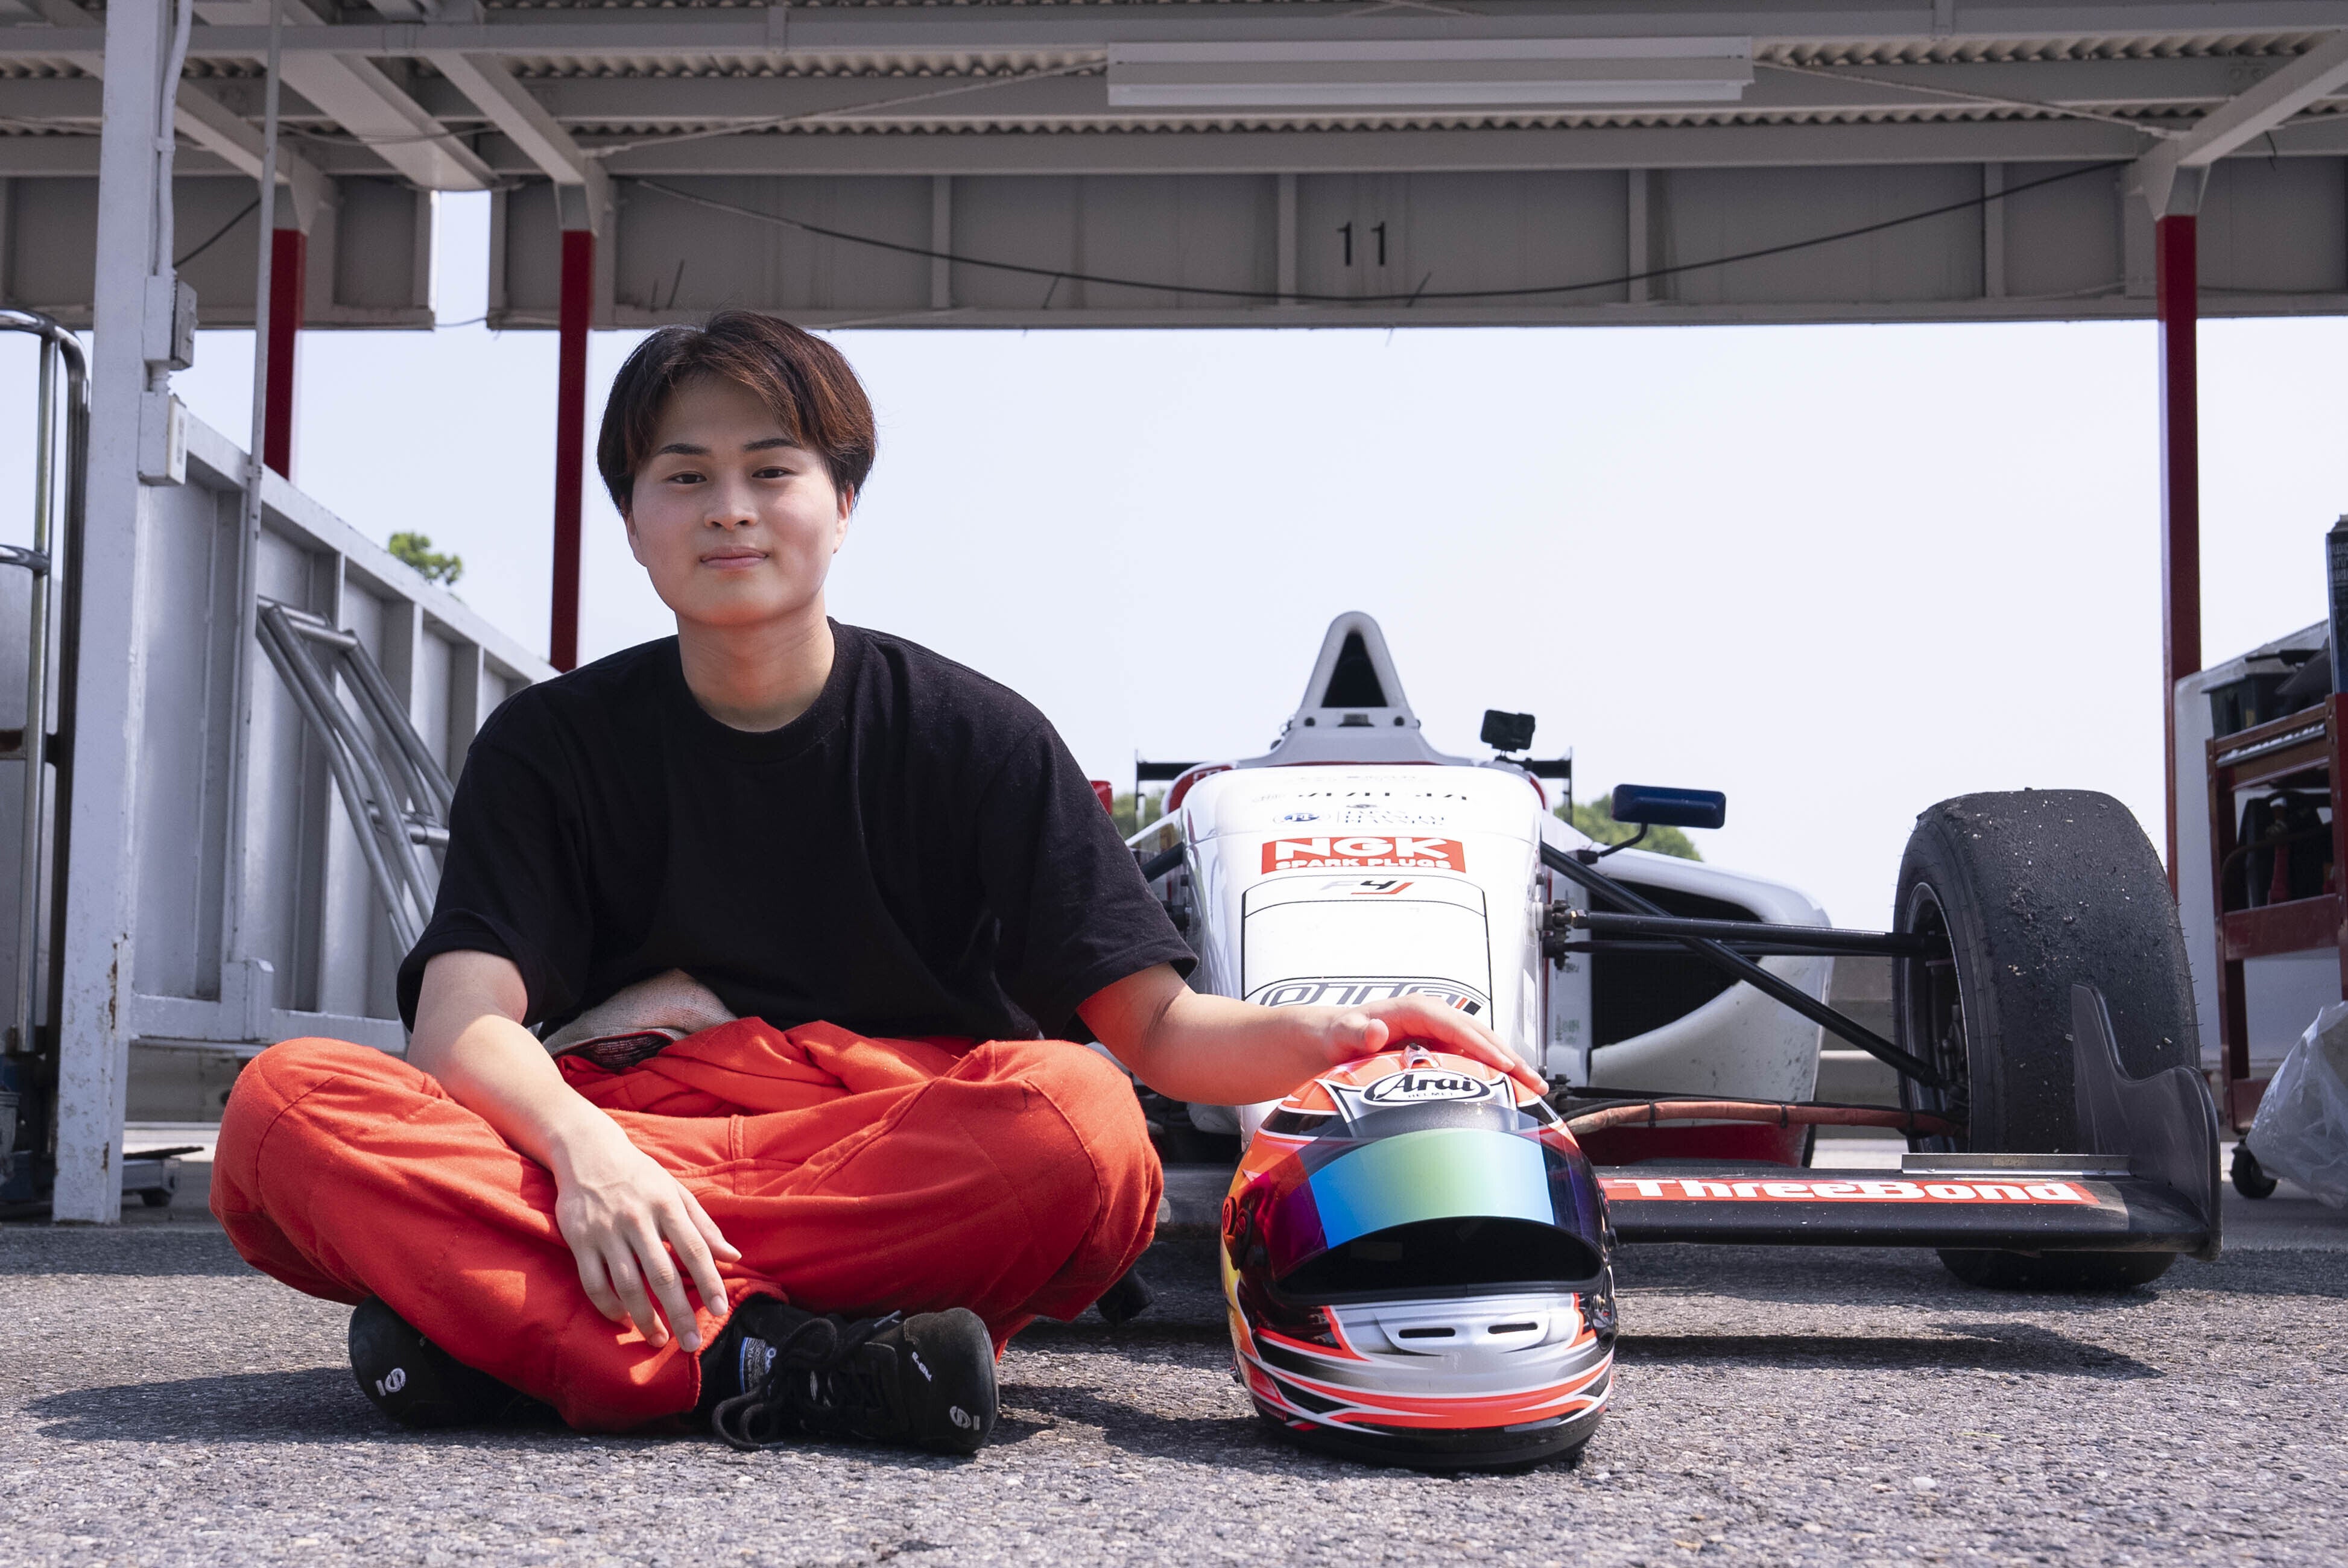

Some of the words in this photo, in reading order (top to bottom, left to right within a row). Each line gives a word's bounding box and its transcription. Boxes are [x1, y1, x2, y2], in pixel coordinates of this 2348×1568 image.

[1337, 221, 1385, 267] 11
[1275, 837, 1449, 860] NGK
[1275, 858, 1360, 870] SPARK
[1367, 858, 1452, 870] PLUGS
[1373, 1073, 1476, 1100] Arai
[1613, 1179, 2083, 1201] ThreeBond
